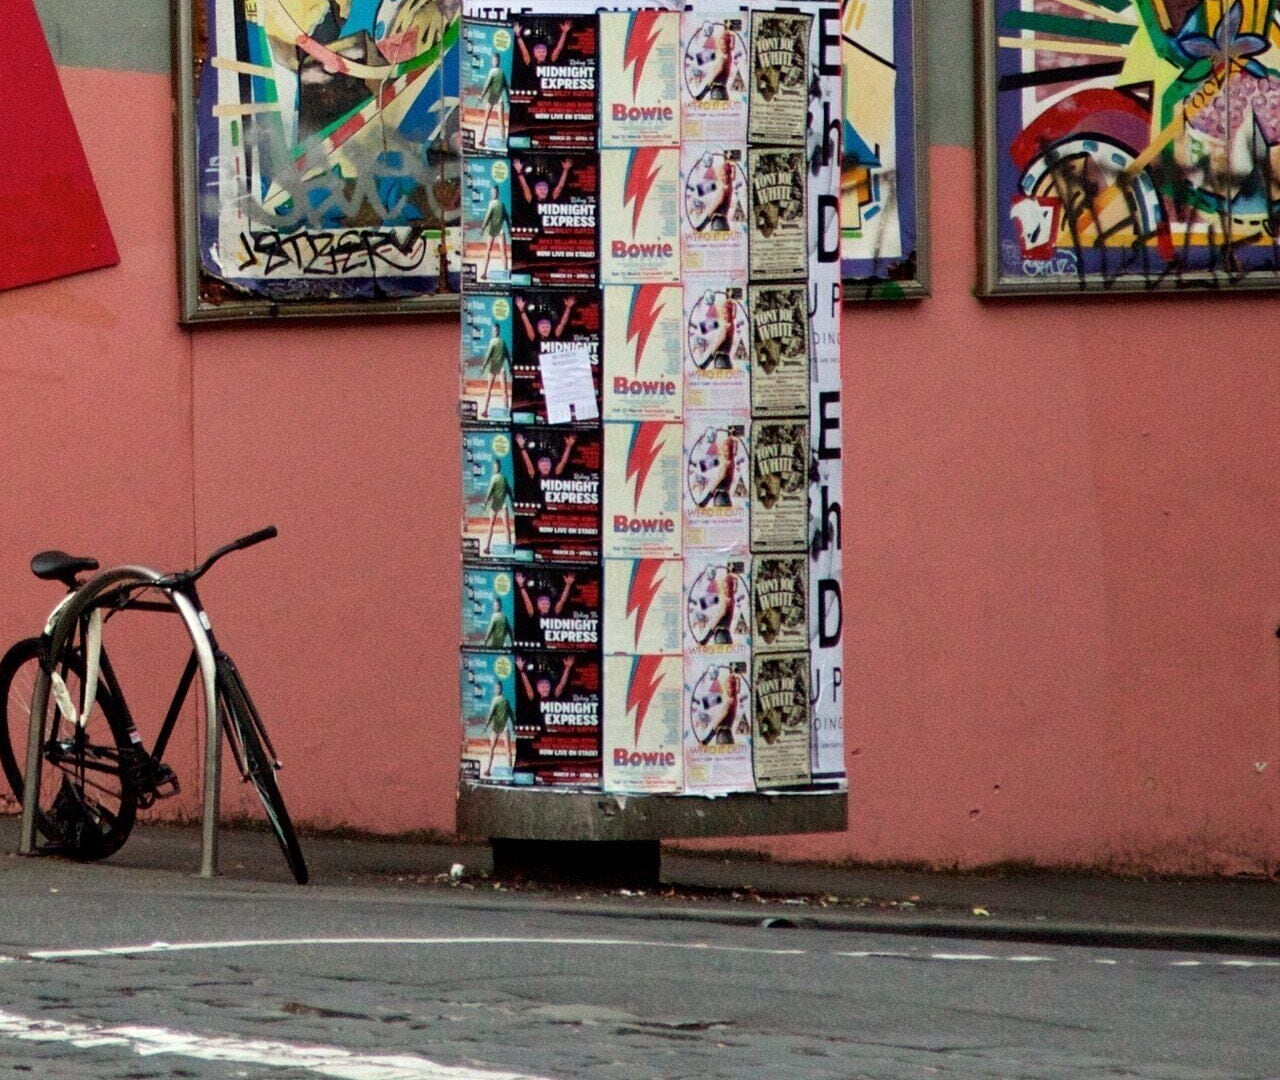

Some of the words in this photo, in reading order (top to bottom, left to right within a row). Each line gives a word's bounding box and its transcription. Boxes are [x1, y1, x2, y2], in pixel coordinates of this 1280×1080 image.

[536, 66, 595, 78] MIDNIGHT
[540, 79, 595, 90] EXPRESS
[612, 103, 673, 121] Bowie
[537, 203, 596, 216] MIDNIGHT
[542, 216, 596, 227] EXPRESS
[611, 240, 673, 258] Bowie
[613, 376, 676, 395] Bowie
[540, 479, 599, 492] MIDNIGHT
[544, 492, 599, 504] EXPRESS
[613, 515, 675, 533] Bowie
[540, 618, 598, 631] MIDNIGHT
[544, 631, 598, 642] EXPRESS
[540, 701, 599, 714] MIDNIGHT
[544, 714, 599, 726] EXPRESS
[613, 748, 676, 767] Bowie
